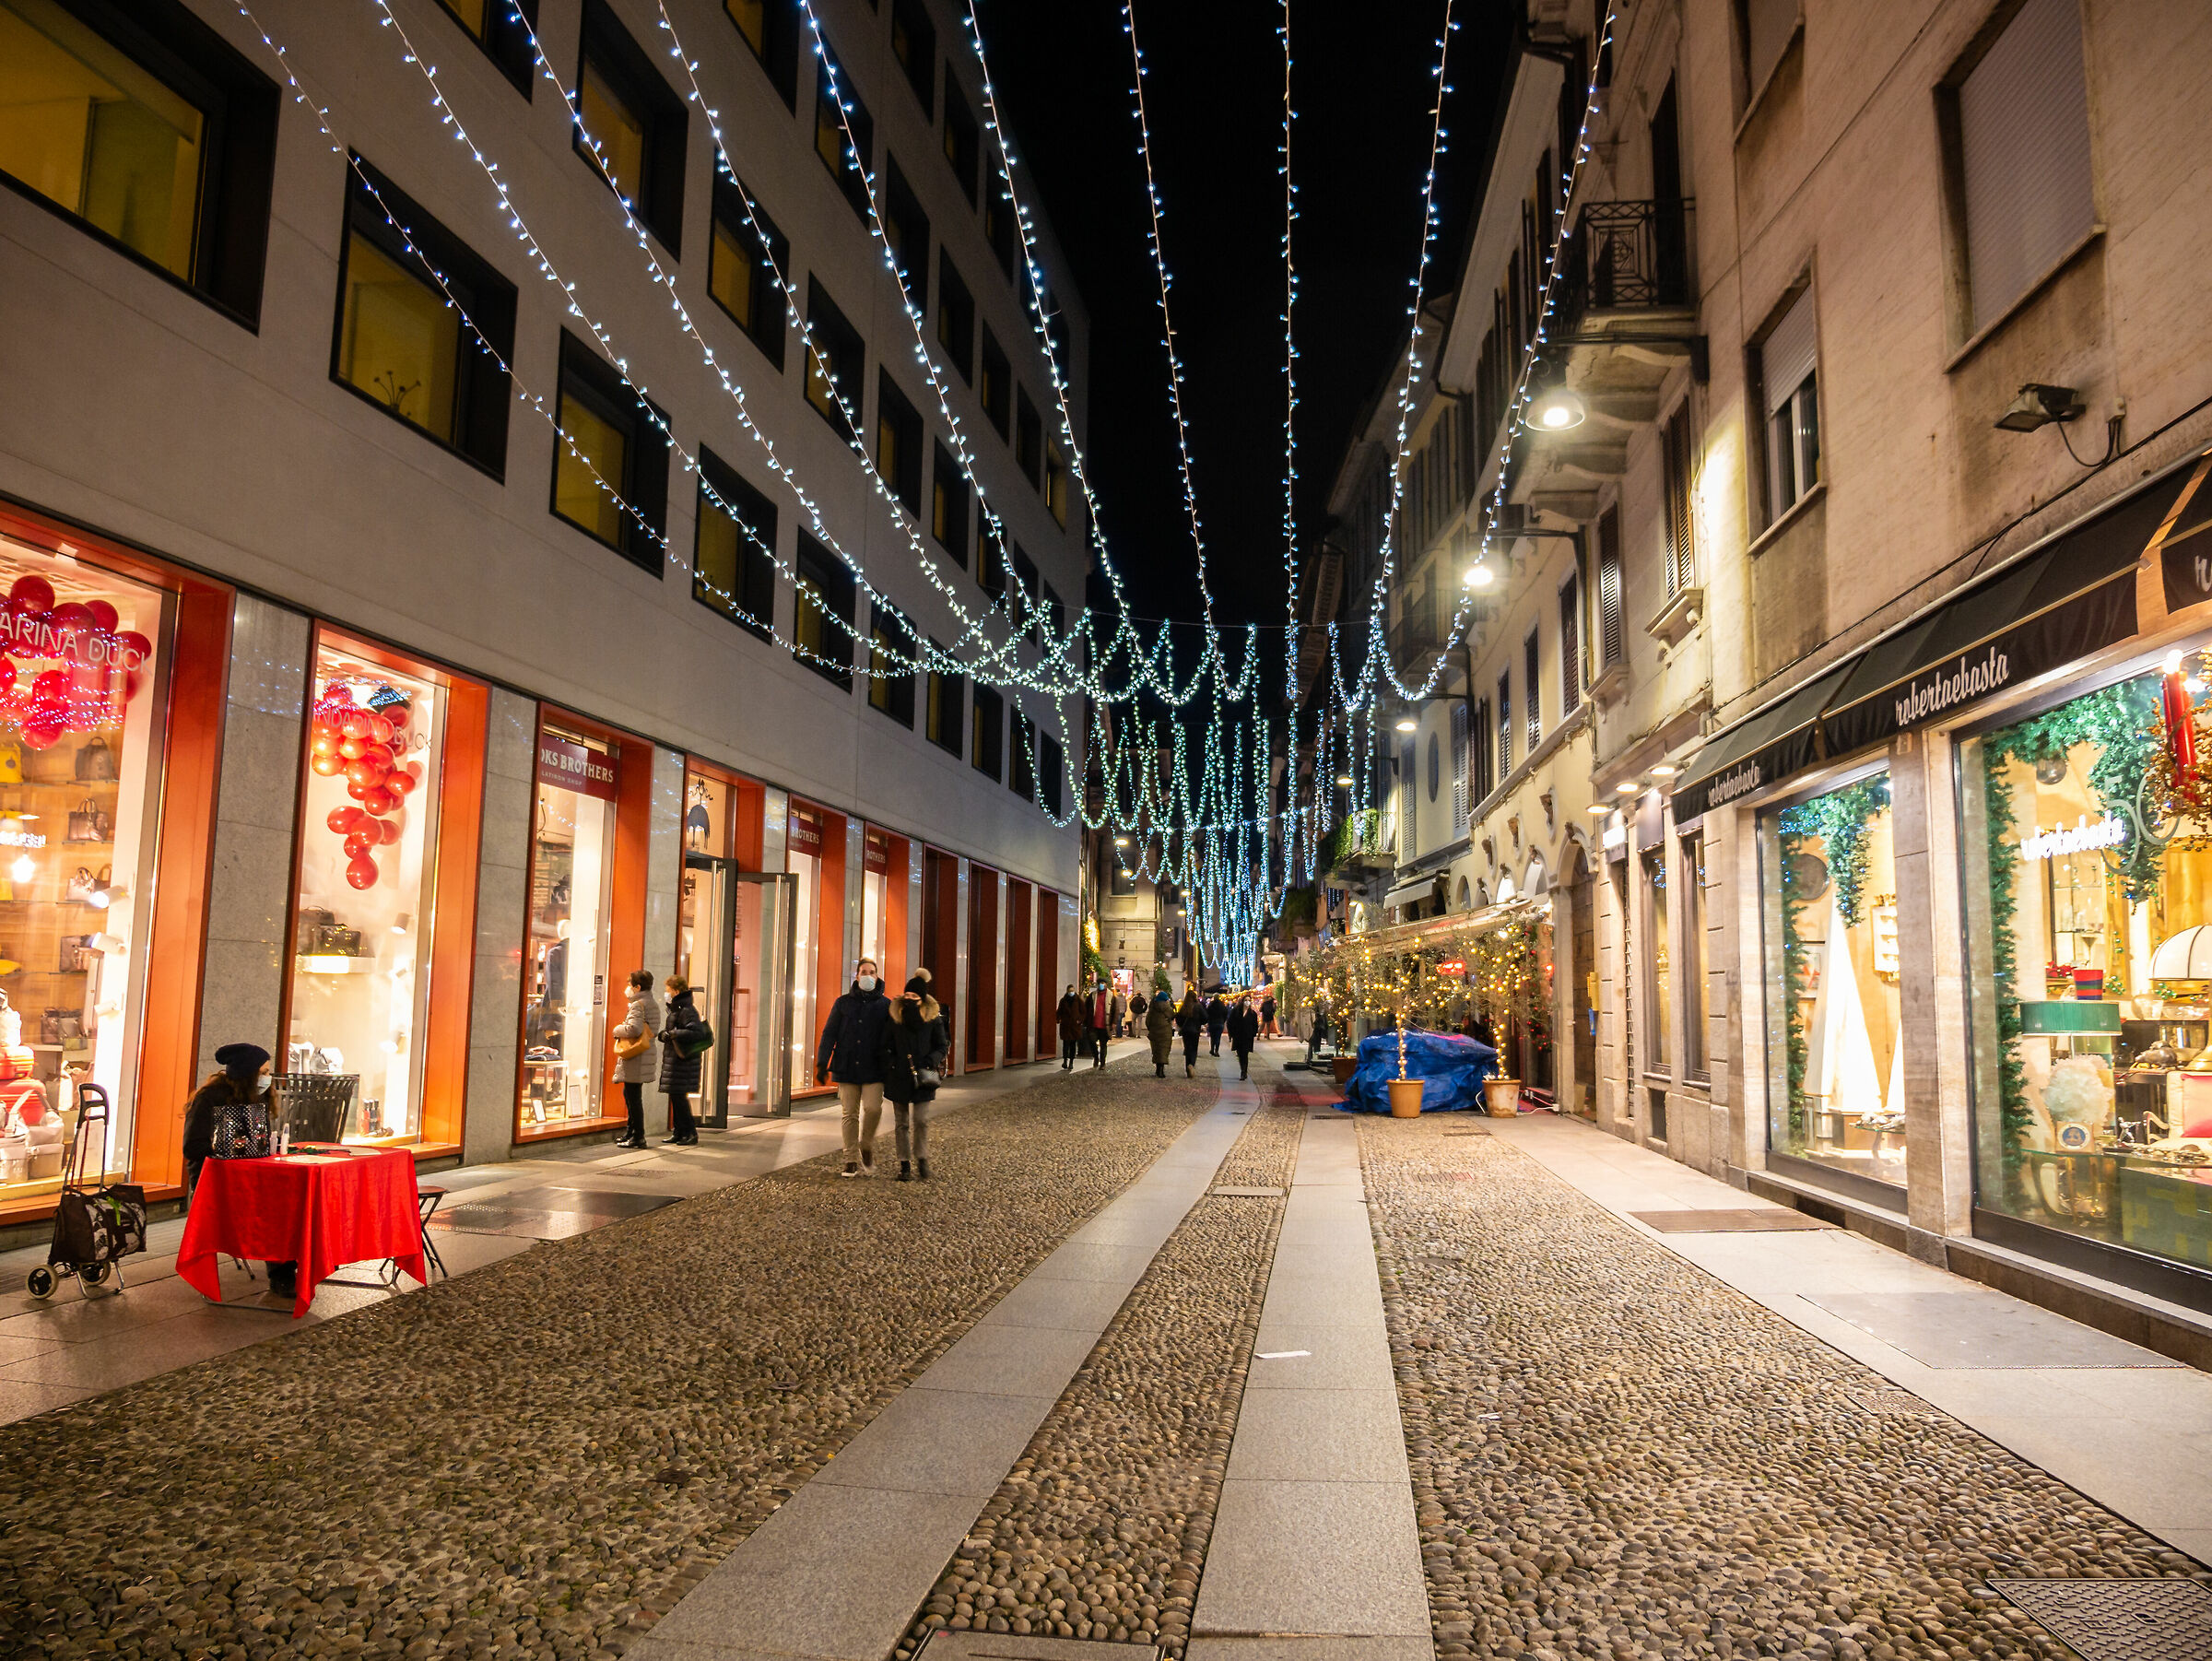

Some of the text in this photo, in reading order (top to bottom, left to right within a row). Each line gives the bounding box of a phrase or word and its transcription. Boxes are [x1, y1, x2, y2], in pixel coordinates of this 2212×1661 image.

[89, 637, 153, 674] DUCK
[1895, 645, 2010, 726] robertaebasta
[394, 725, 433, 753] DUCK
[559, 754, 613, 783] BROTHERS
